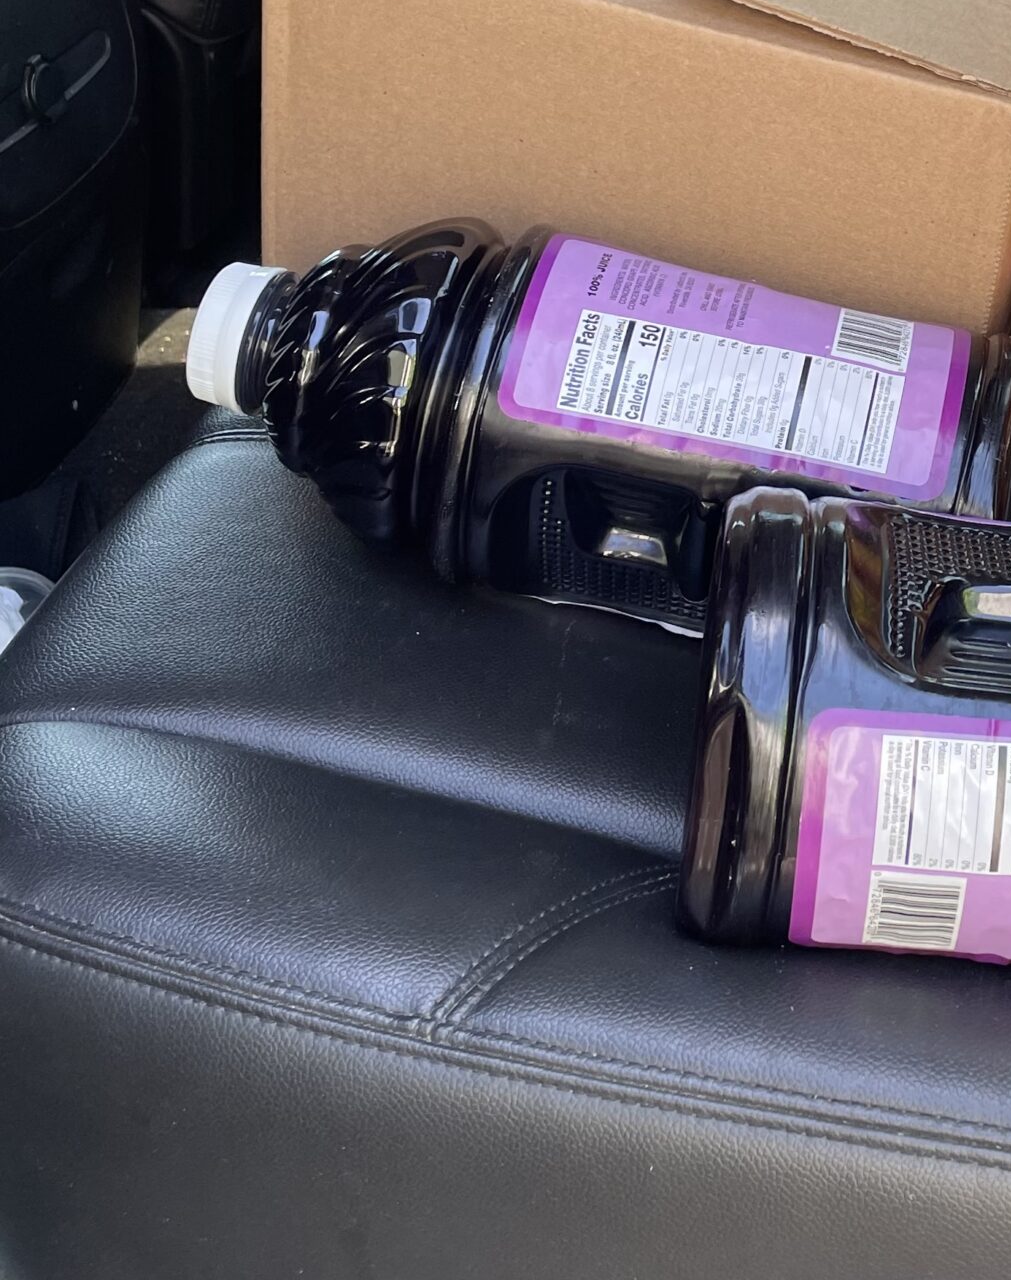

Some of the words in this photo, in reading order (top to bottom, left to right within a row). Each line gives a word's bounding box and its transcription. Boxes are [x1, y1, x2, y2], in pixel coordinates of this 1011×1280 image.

[586, 273, 603, 297] 100%
[595, 252, 612, 272] JUICE
[598, 324, 610, 350] container
[662, 343, 670, 355] Daily
[559, 347, 590, 408] Nutrition
[576, 311, 599, 346] Facts
[595, 350, 605, 361] per
[588, 360, 602, 386] servings
[594, 387, 607, 413] Serving
[601, 372, 610, 386] size
[610, 342, 618, 351] oz.
[624, 371, 648, 420] Calories
[638, 323, 660, 349] 150
[614, 393, 624, 416] Amount
[624, 359, 635, 382] serving
[582, 391, 592, 411] About
[662, 398, 670, 409] Fat
[727, 382, 742, 422] Carbohydrate
[658, 409, 667, 425] Total
[697, 398, 710, 433] Cholesterol
[710, 412, 720, 436] Sodium
[723, 422, 732, 438] Total
[775, 426, 785, 448] Protein
[921, 740, 930, 764] Vitamin
[937, 741, 946, 774] Potassium
[970, 743, 978, 769] Calcium
[986, 744, 994, 769] Vitamin
